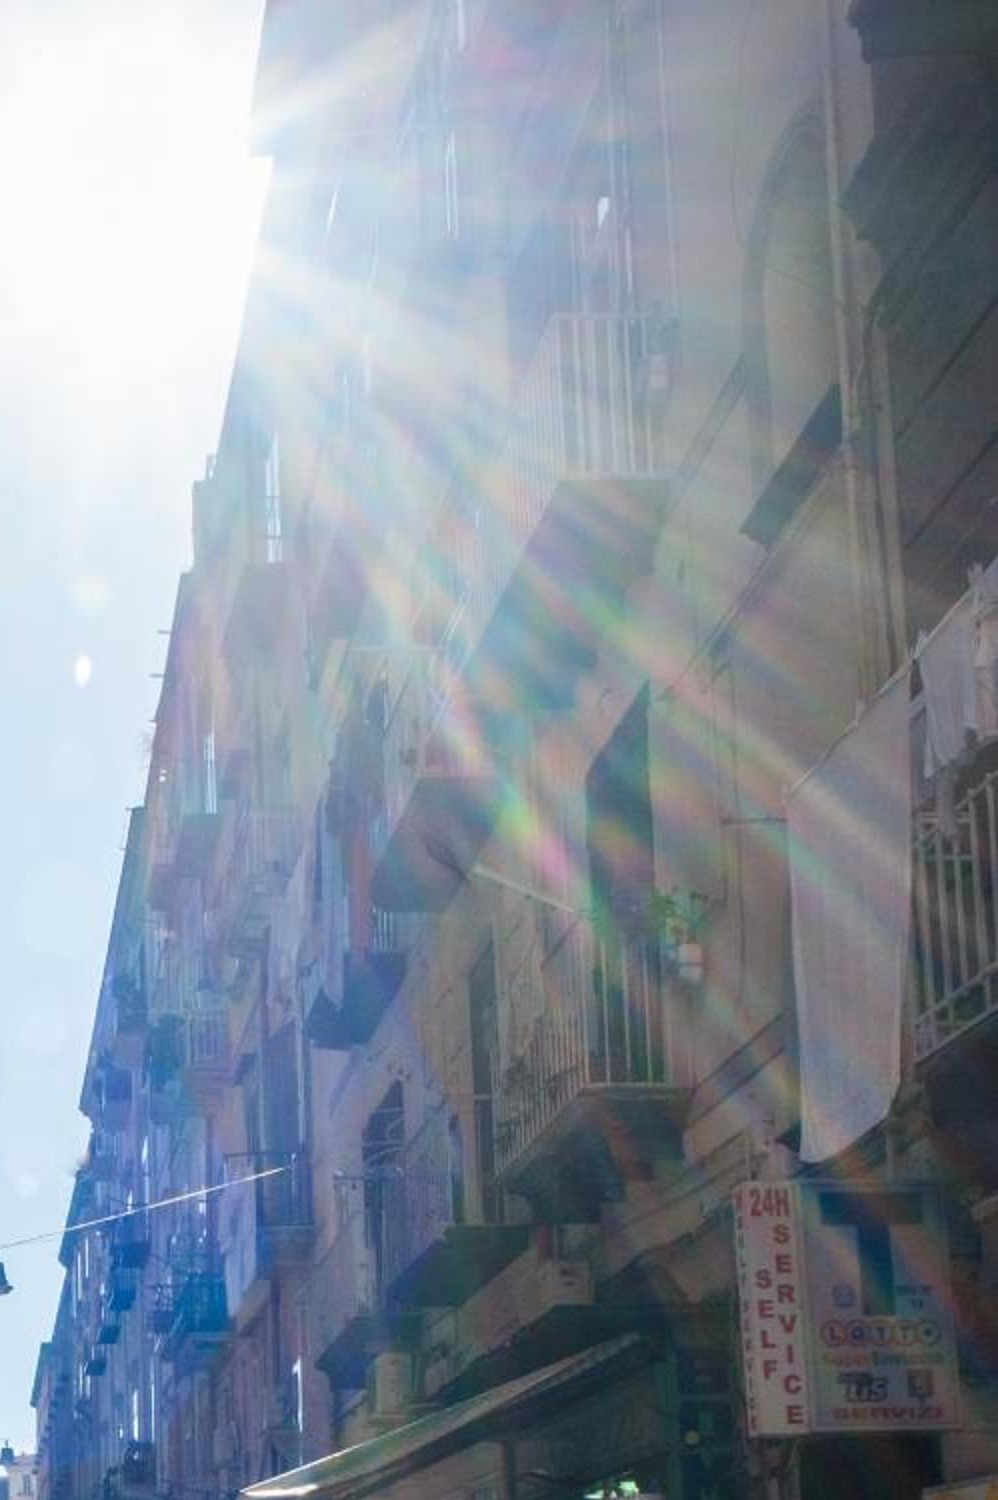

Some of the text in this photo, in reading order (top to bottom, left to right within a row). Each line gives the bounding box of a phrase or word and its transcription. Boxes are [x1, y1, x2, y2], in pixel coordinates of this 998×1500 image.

[749, 1187, 789, 1217] 24H
[755, 1268, 778, 1379] SELF
[773, 1223, 803, 1425] SERVICE
[821, 1319, 940, 1347] LOTTO
